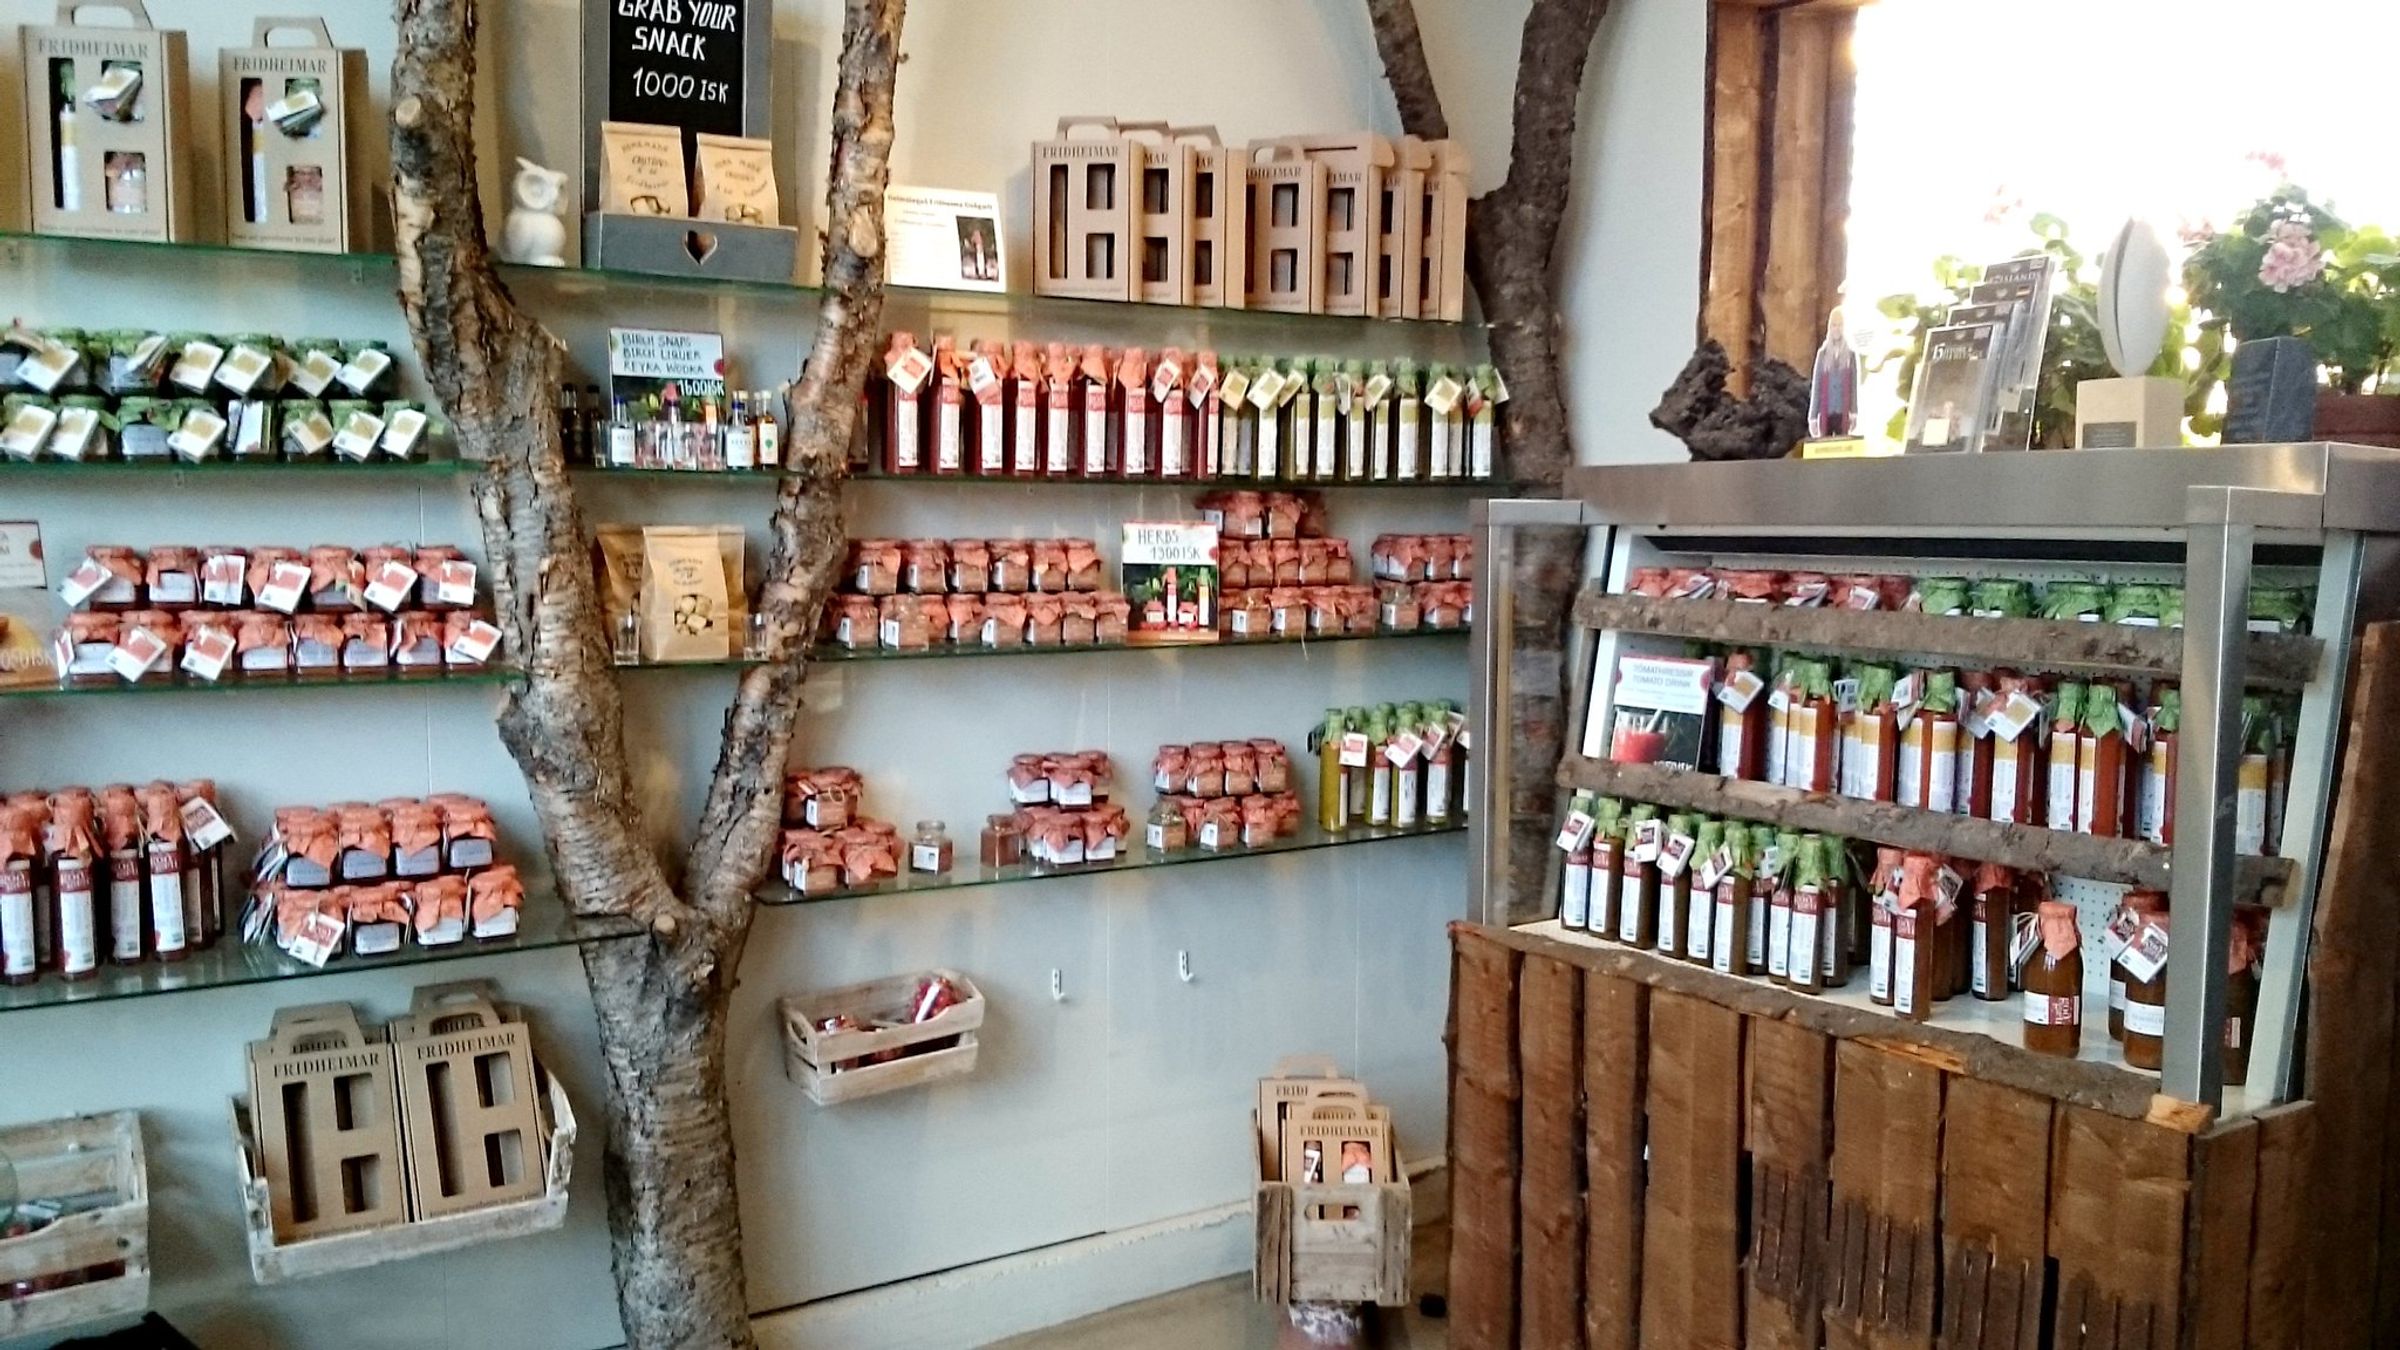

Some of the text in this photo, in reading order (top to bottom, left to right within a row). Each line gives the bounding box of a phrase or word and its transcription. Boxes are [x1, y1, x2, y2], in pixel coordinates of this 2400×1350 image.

[618, 0, 737, 32] GRAB YOUR
[632, 27, 706, 61] SNACK
[633, 67, 729, 104] 1000 ISK
[622, 333, 654, 346] BIRCH
[623, 347, 655, 359] BIRCH
[1138, 528, 1180, 545] HERBS
[1633, 675, 1691, 688] TOMATO DRINK
[417, 1032, 516, 1060] FRIDHEIMAR
[274, 1052, 380, 1078] FRIDHEIMAR
